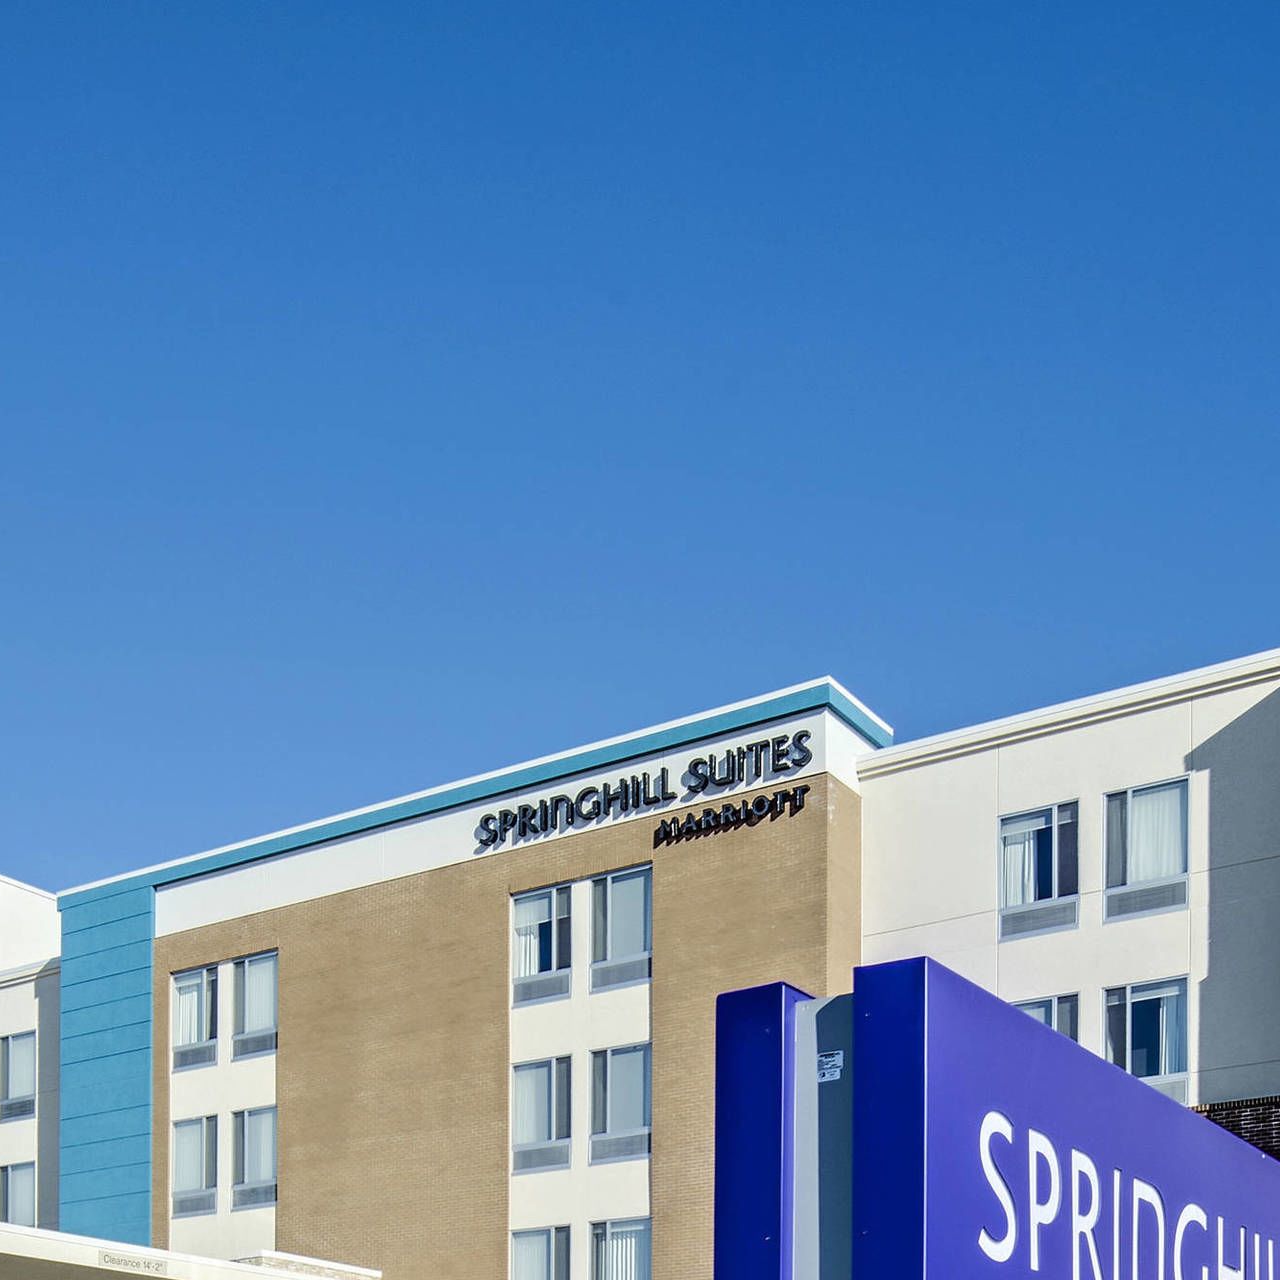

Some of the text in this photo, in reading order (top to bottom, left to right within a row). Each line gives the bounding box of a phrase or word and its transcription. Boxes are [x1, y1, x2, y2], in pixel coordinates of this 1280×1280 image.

[479, 729, 813, 847] SPRINGHILL SUITES
[657, 784, 811, 840] MARRIOTT
[103, 1254, 141, 1269] Clearance
